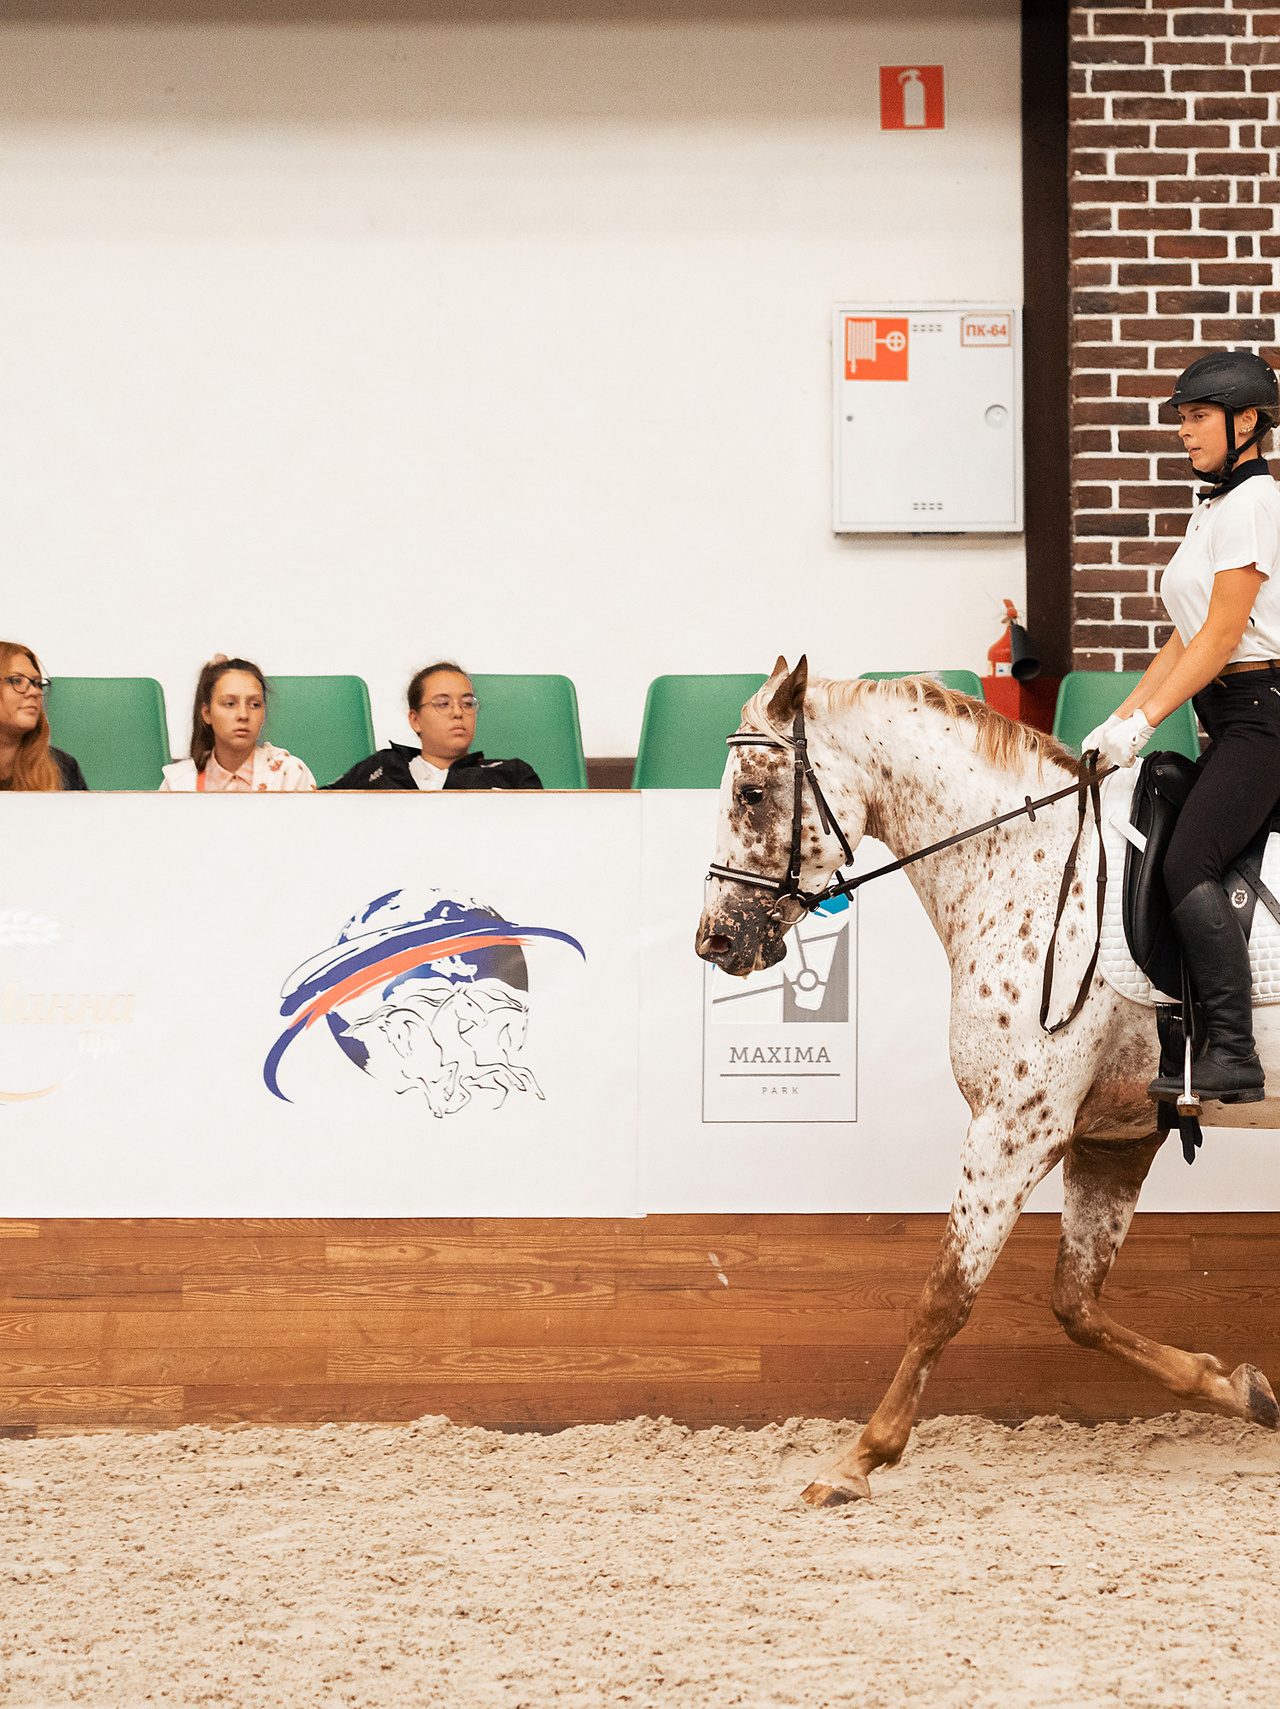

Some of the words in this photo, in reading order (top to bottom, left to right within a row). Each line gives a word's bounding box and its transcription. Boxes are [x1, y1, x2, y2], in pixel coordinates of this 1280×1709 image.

[966, 324, 1006, 336] ПК-64
[729, 1046, 831, 1063] MAXIMA
[761, 1086, 799, 1095] PARK
